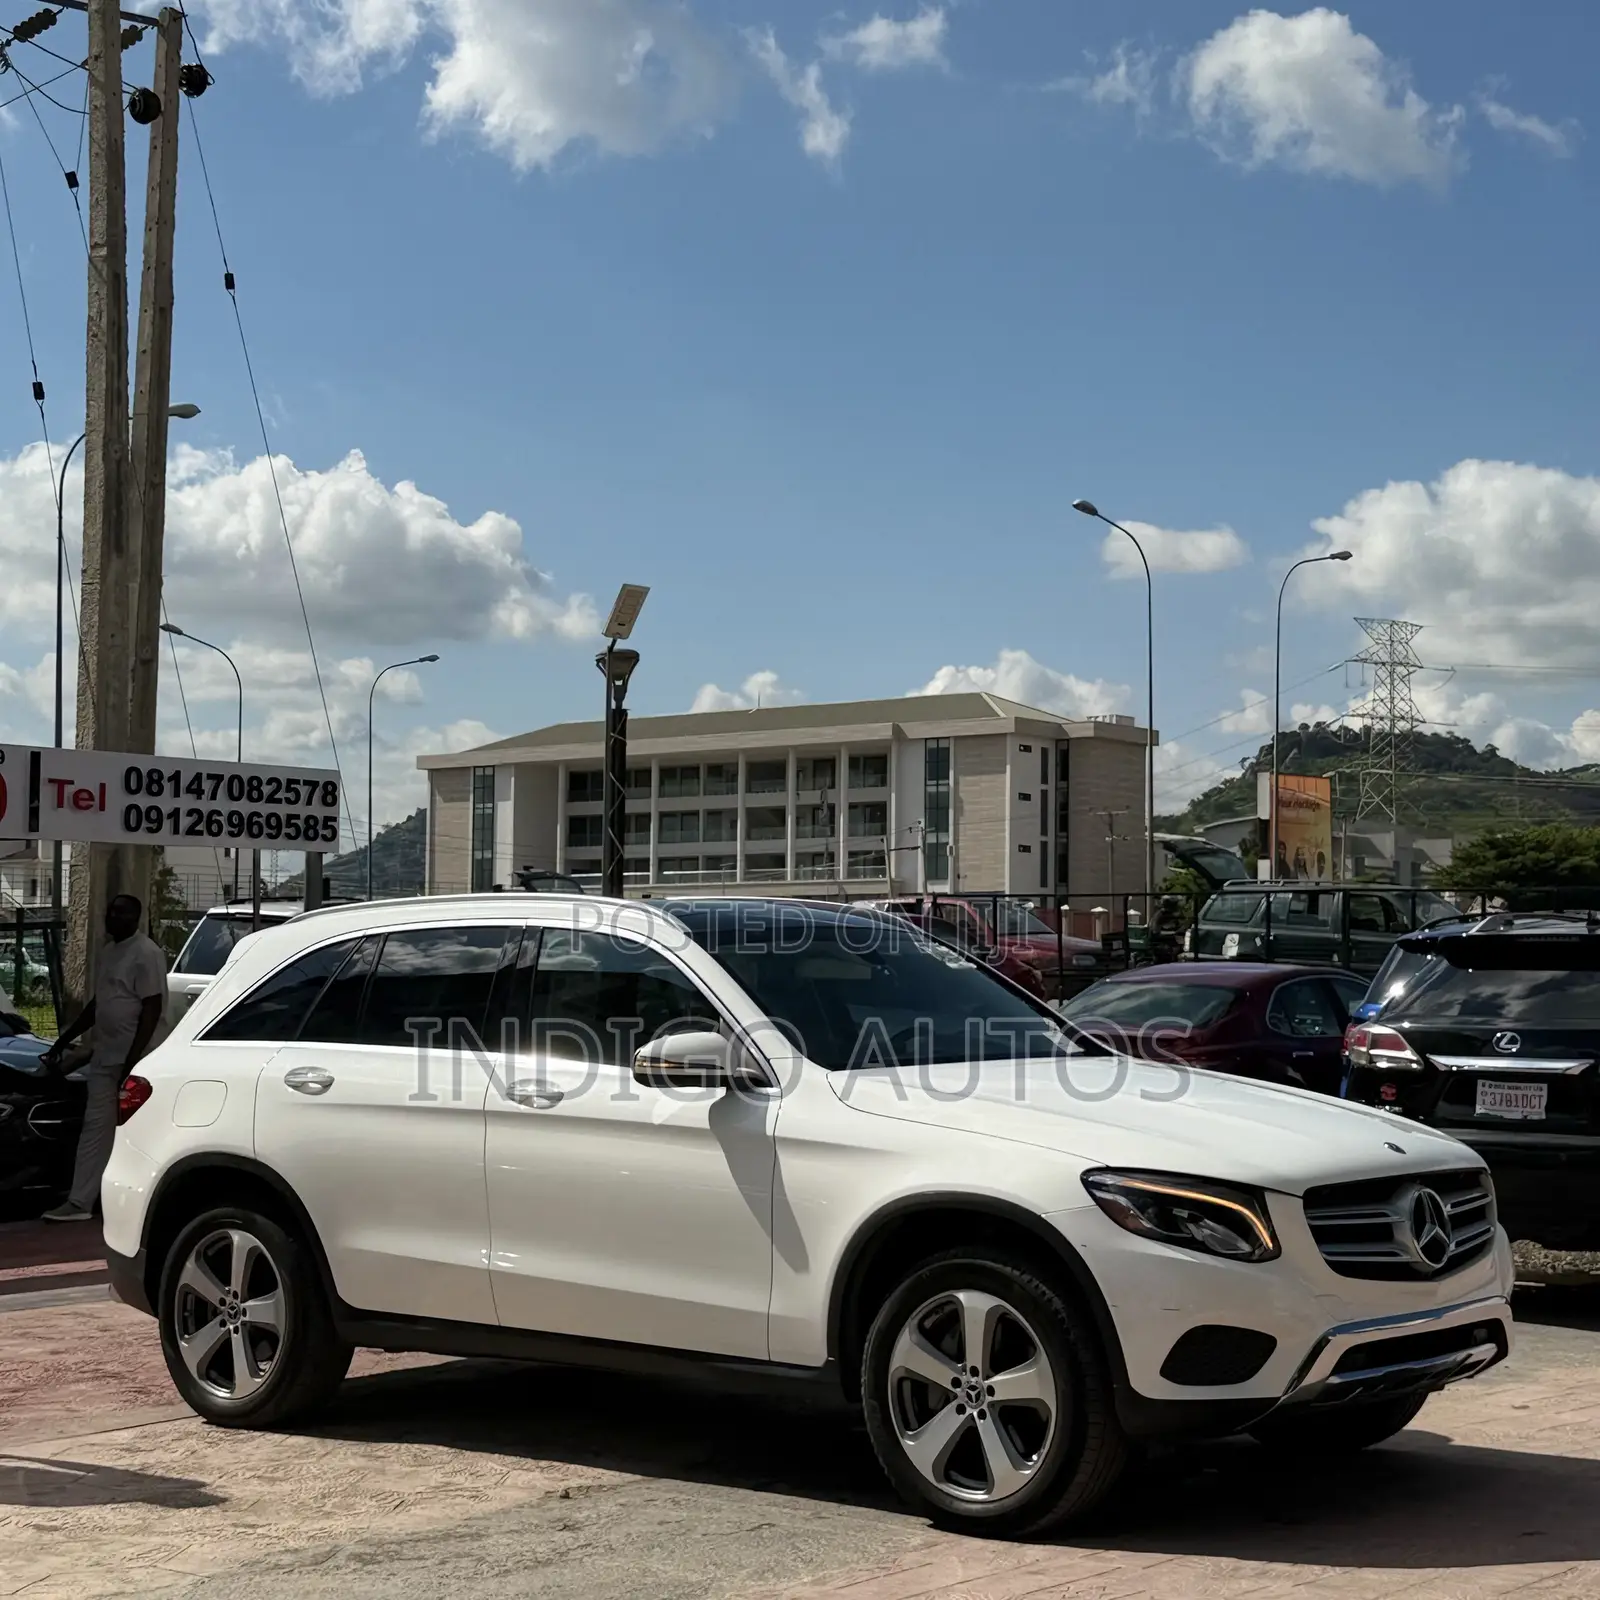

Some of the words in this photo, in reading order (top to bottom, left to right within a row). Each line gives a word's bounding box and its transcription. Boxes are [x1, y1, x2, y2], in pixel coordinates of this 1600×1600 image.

[47, 777, 107, 812] Tel
[124, 765, 339, 807] 08147082578
[123, 802, 339, 842] 09126969585
